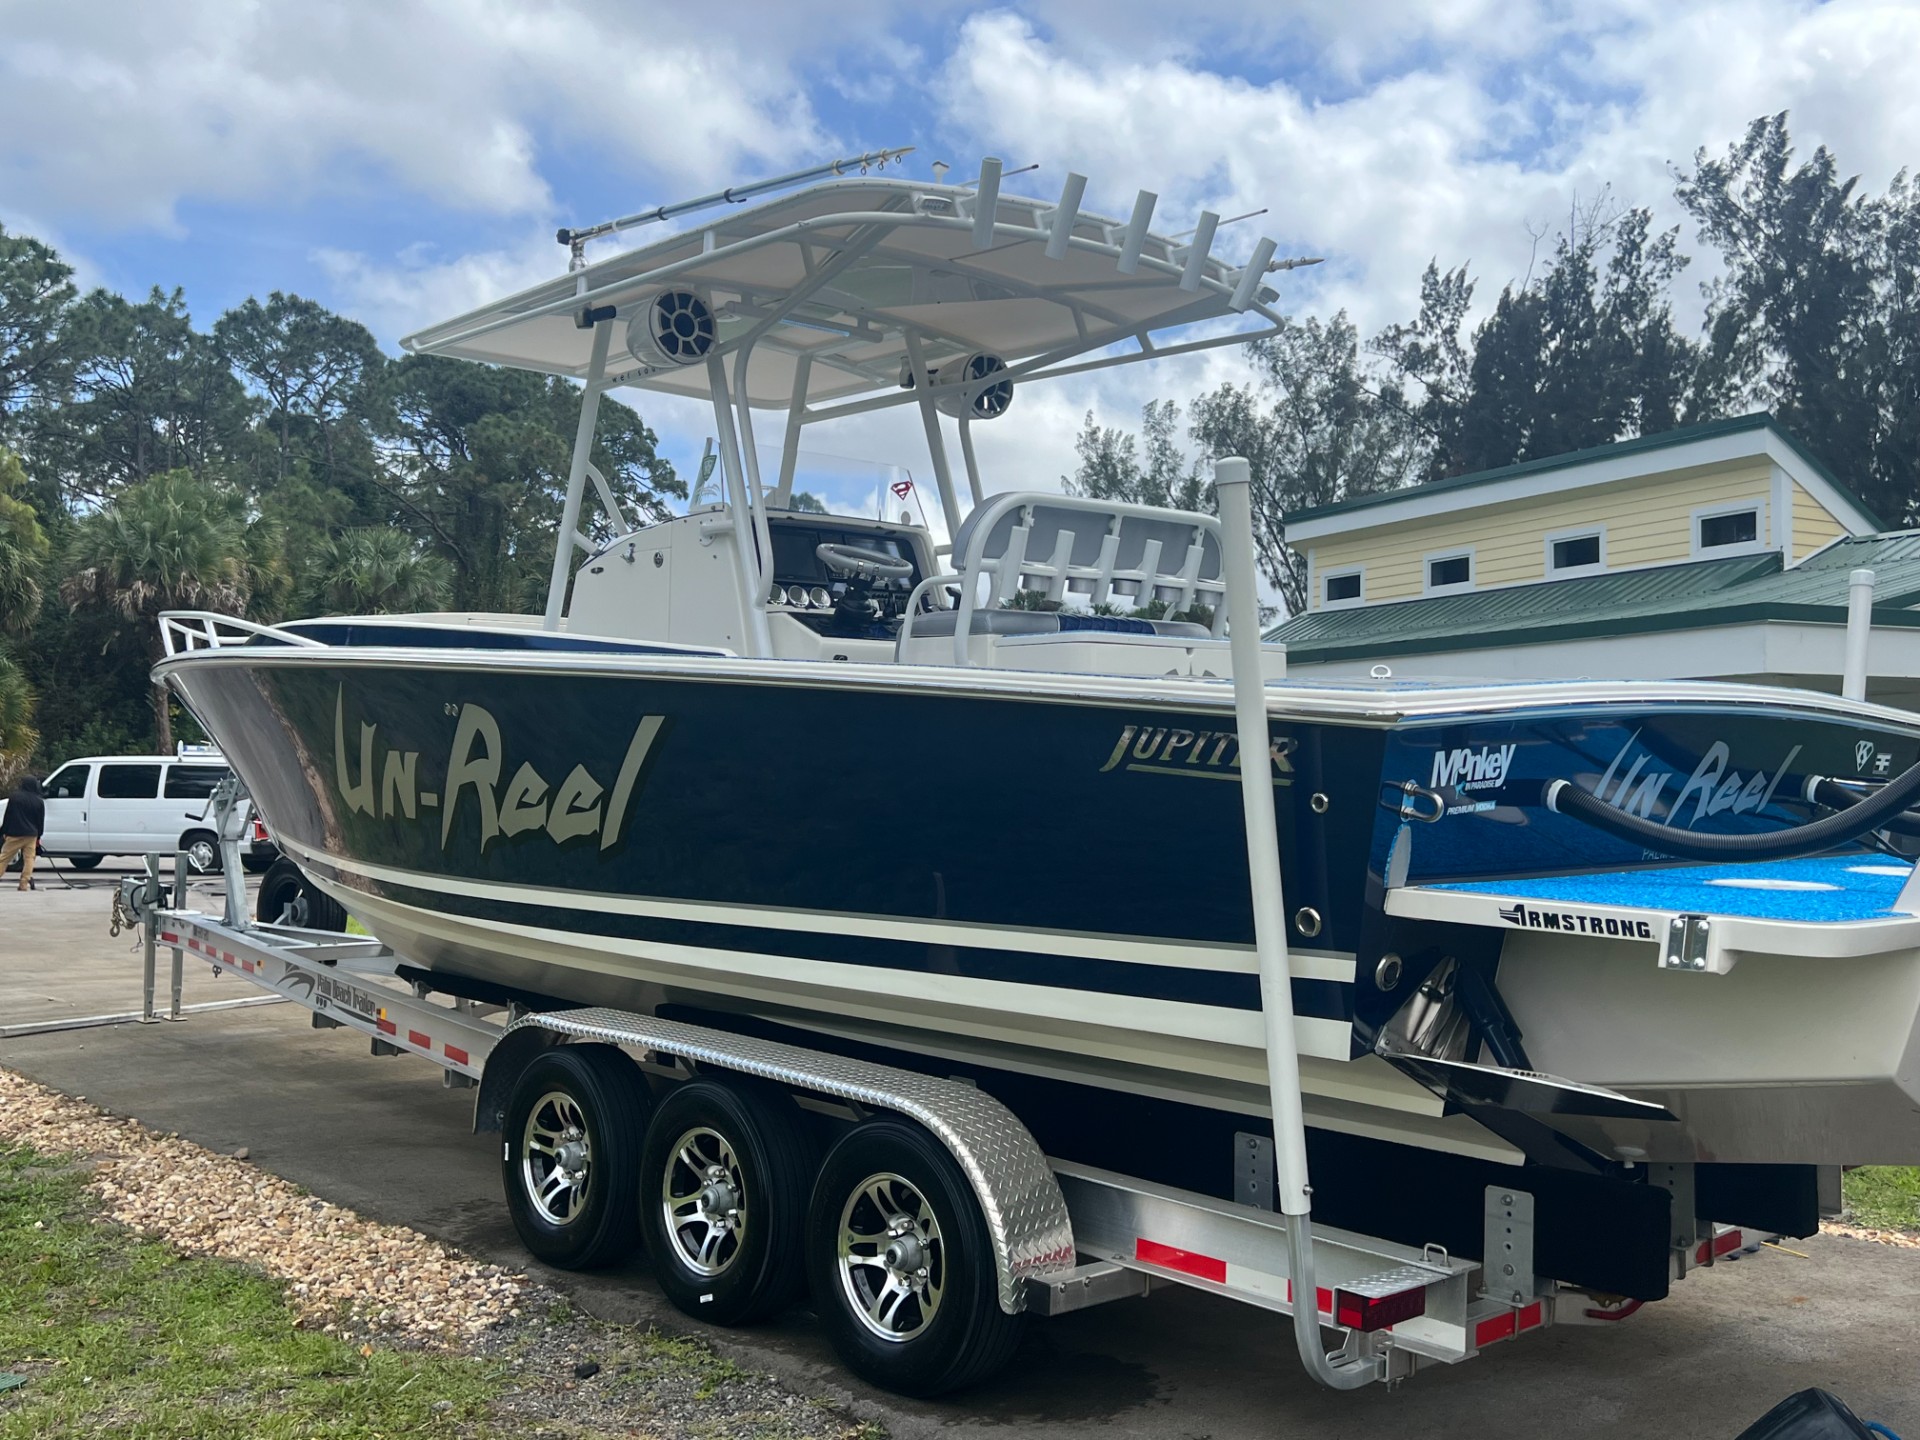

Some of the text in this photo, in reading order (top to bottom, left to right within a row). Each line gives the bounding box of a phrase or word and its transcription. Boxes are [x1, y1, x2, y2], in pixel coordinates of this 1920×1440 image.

[1099, 725, 1298, 773] JUPITR
[1430, 743, 1517, 789] Monkey
[1664, 740, 1803, 830] Reel
[1446, 804, 1475, 816] PREMIUM
[1499, 904, 1651, 939] ARMSTRONG
